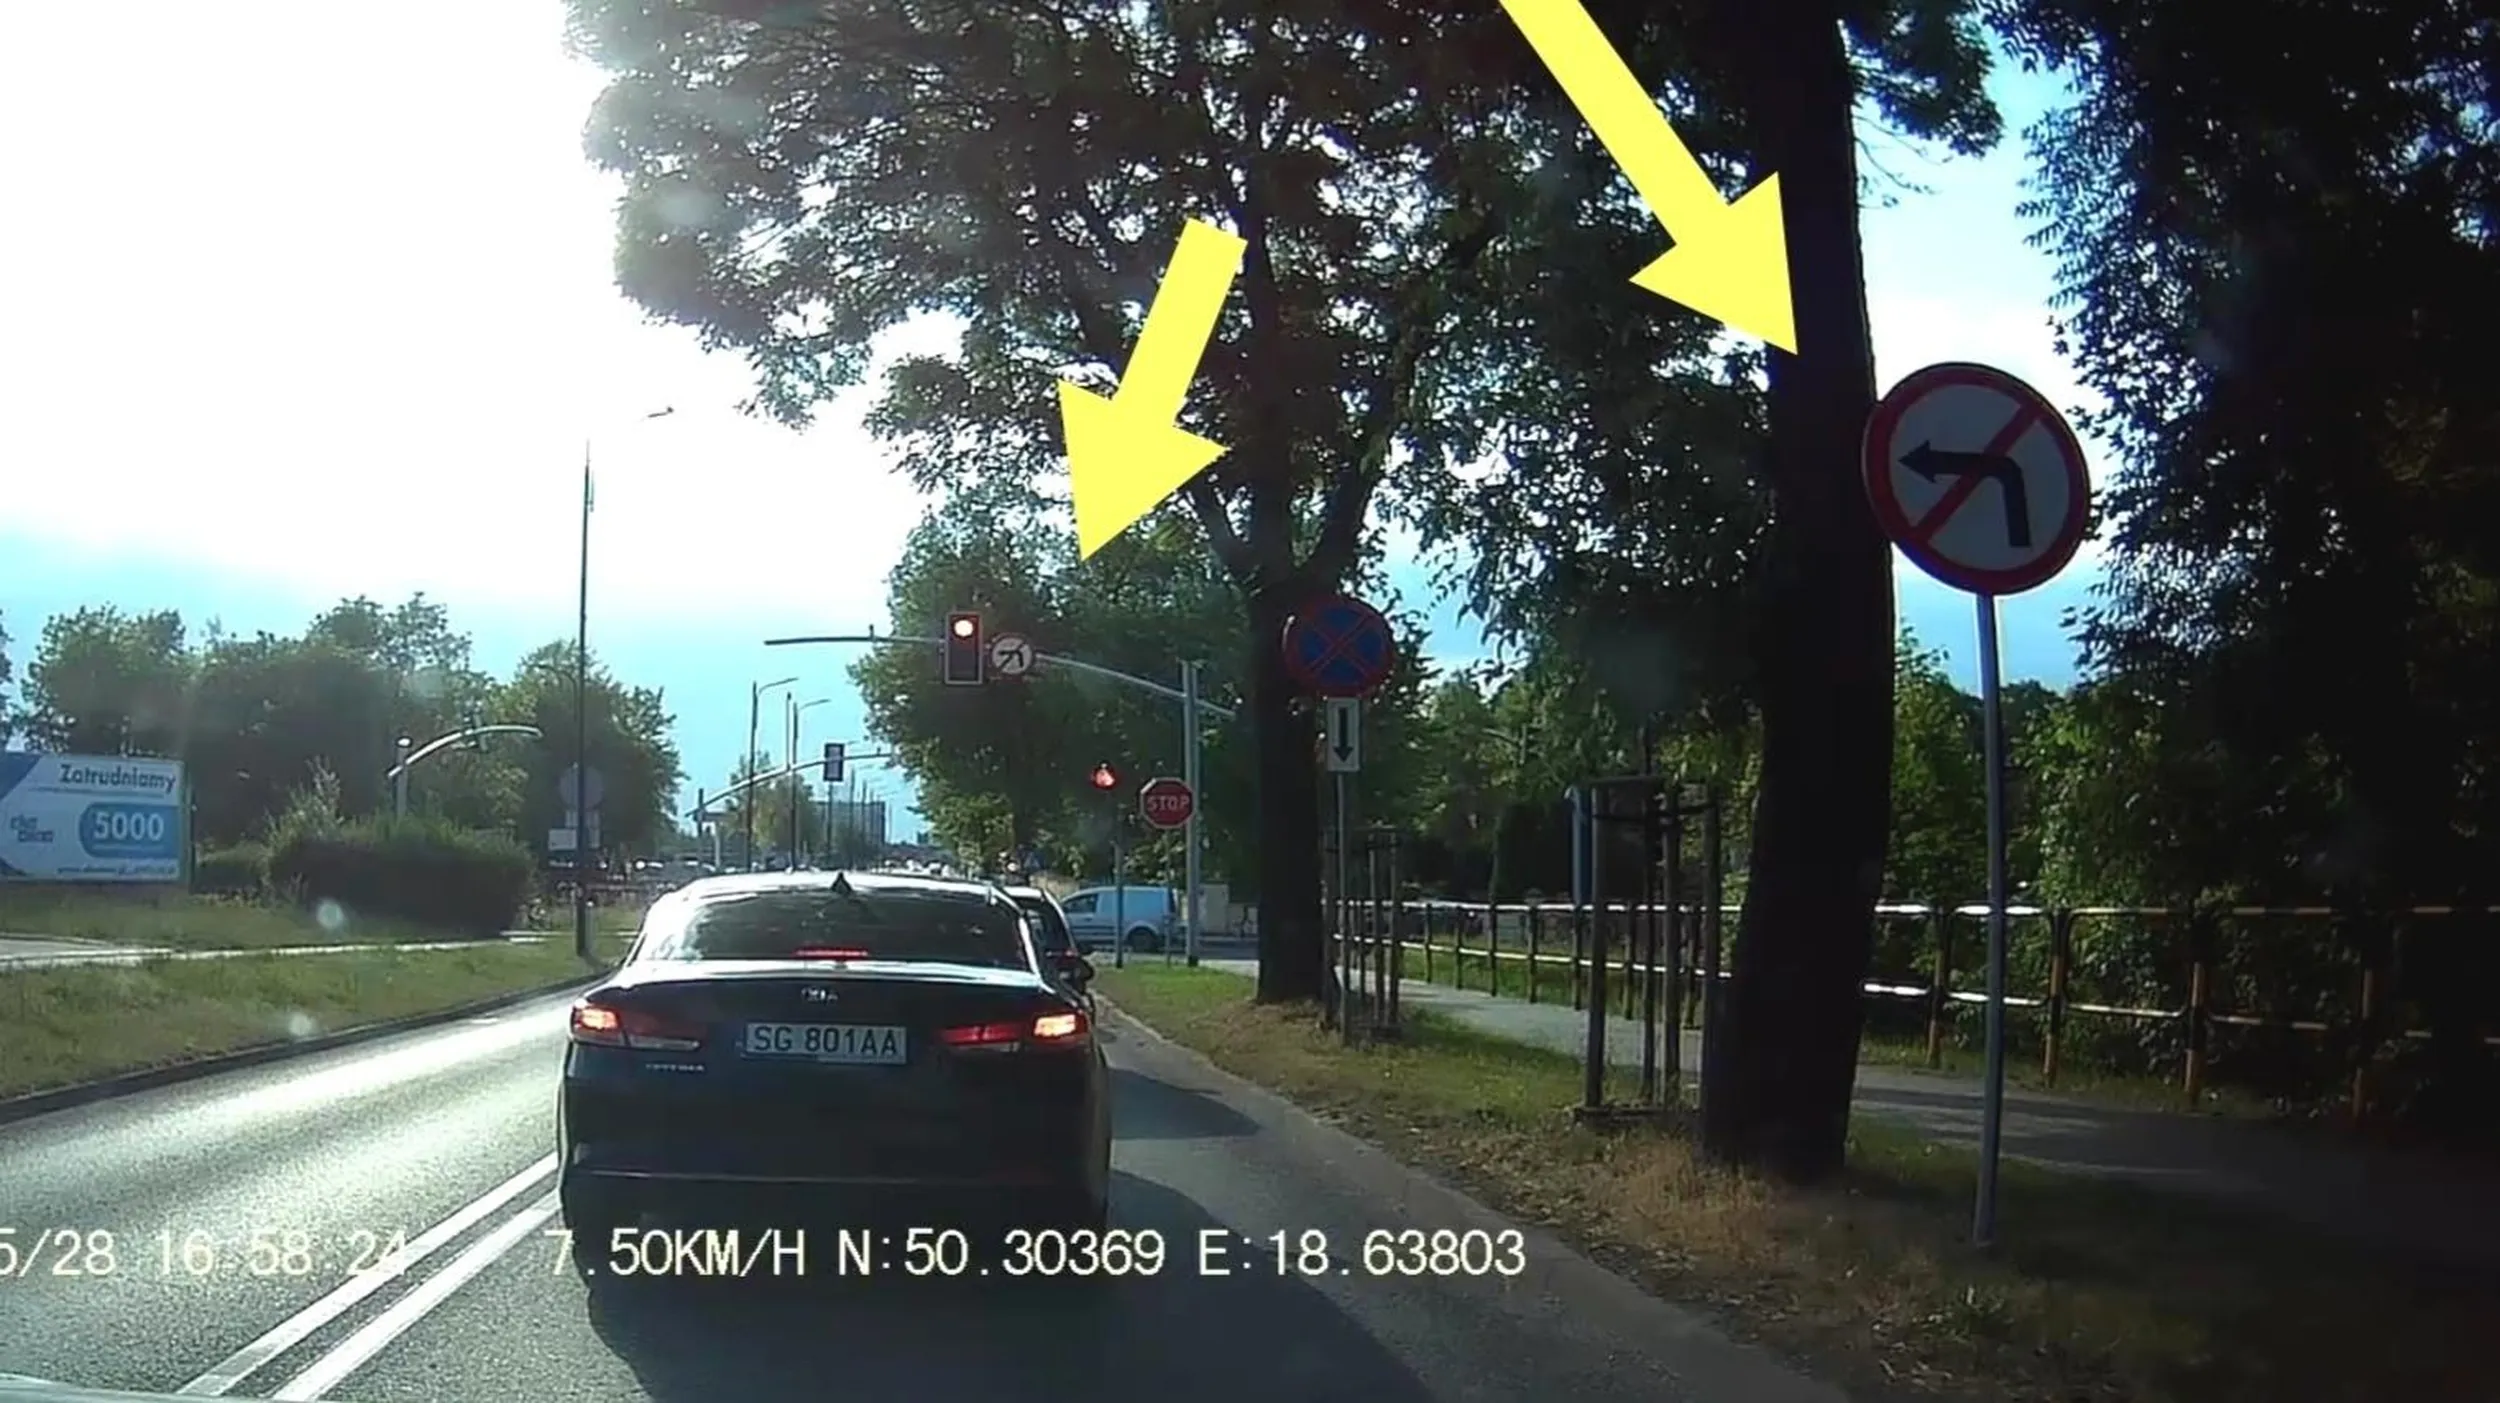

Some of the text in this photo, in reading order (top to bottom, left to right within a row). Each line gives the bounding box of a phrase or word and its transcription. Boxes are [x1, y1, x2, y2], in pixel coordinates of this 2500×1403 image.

[60, 764, 176, 795] Zatrudniamy
[1147, 796, 1190, 811] STOP
[94, 812, 164, 841] 5000
[754, 1026, 898, 1056] SG 801AA
